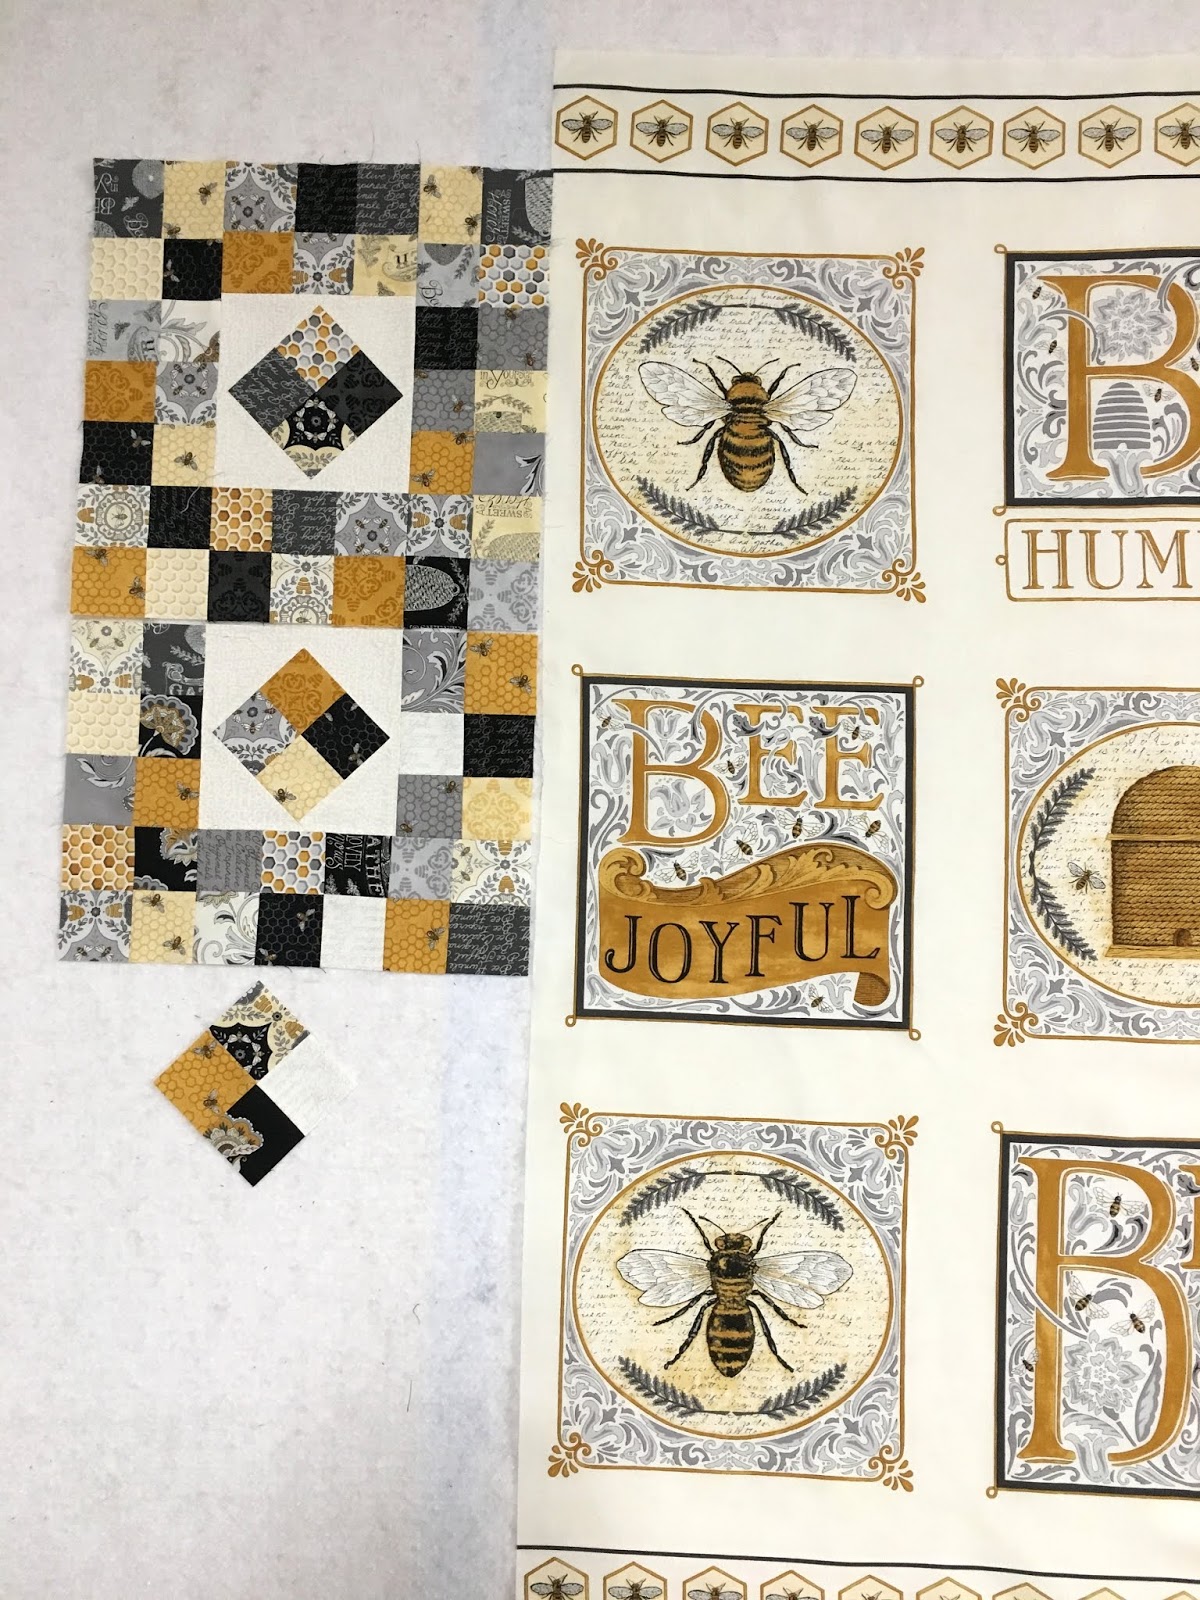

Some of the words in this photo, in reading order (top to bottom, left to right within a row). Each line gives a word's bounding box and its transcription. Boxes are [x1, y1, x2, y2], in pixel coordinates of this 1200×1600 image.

[485, 192, 502, 242] Honey
[502, 199, 510, 234] SWEET
[487, 509, 522, 518] SWEET
[1021, 529, 1200, 590] HUM
[611, 698, 885, 847] BEE
[344, 835, 362, 871] LOVELY
[449, 913, 485, 924] Humbl
[604, 895, 881, 984] JOYFUL
[1018, 1157, 1200, 1466] B
